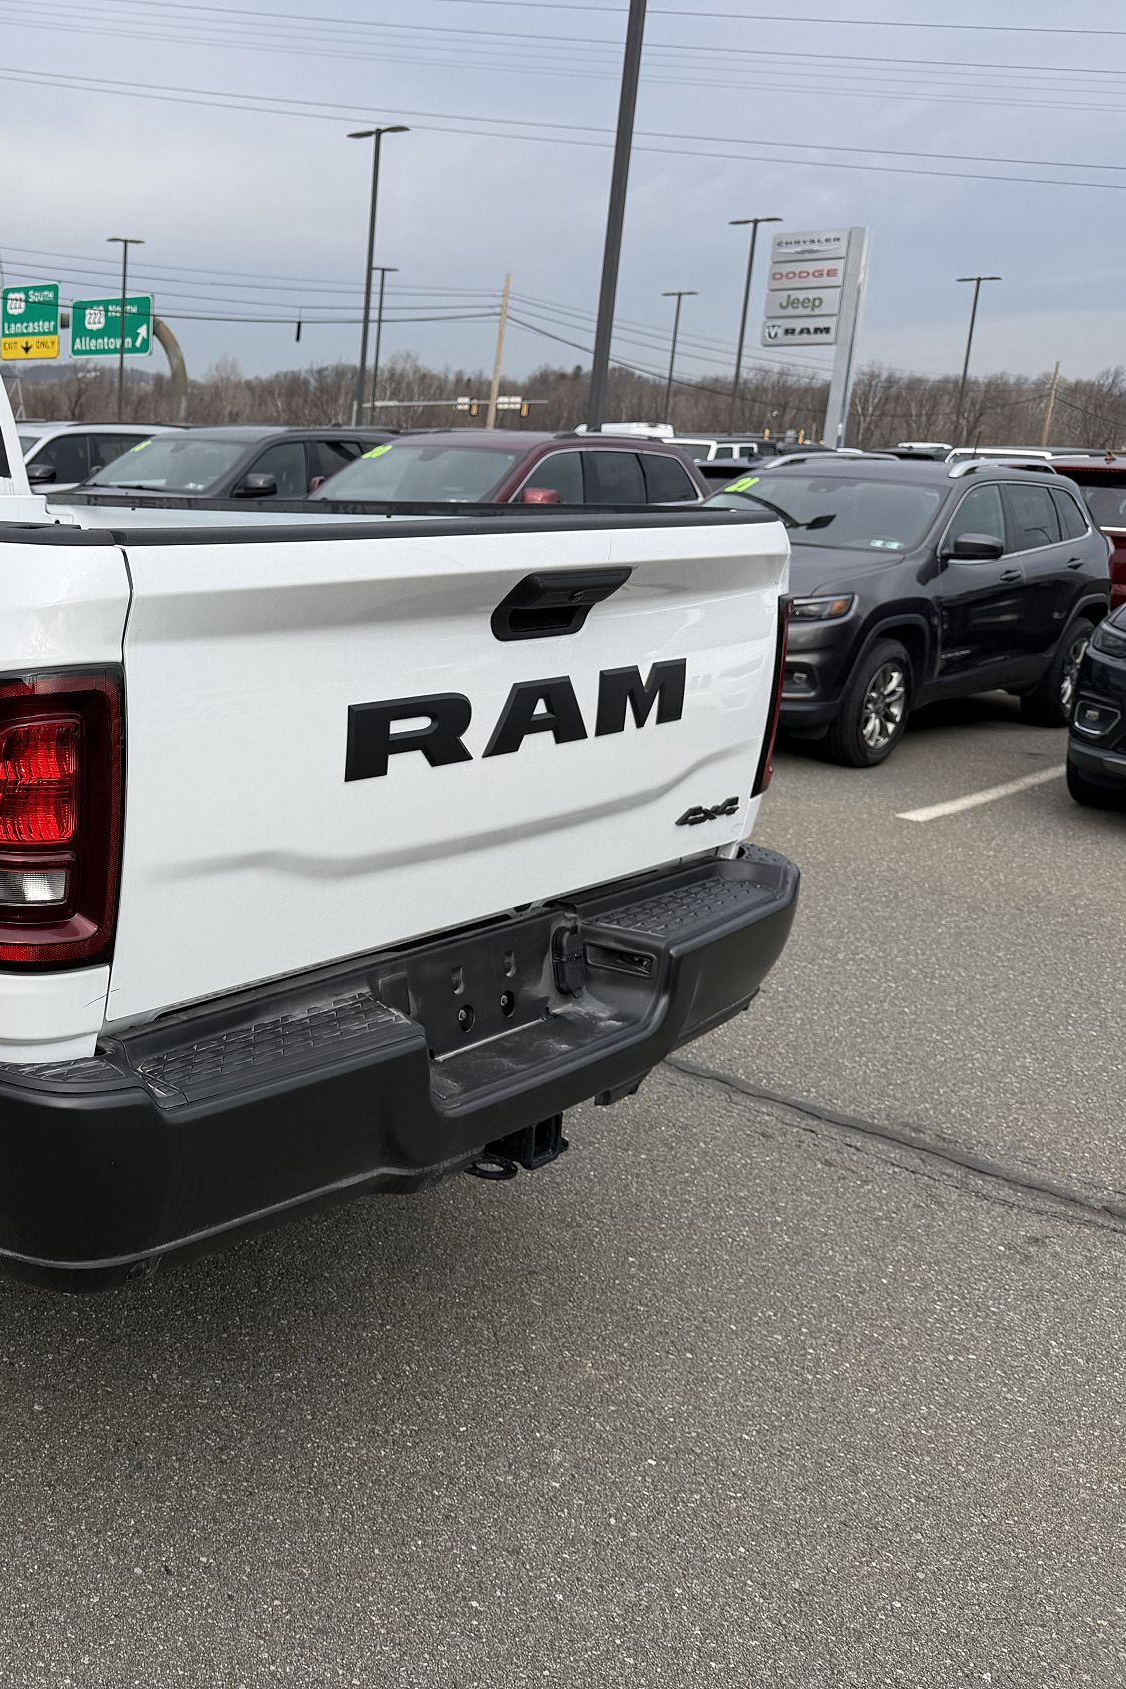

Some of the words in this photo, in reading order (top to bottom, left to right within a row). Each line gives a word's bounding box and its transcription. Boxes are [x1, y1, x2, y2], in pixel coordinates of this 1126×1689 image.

[777, 237, 841, 247] CHRYSLER
[772, 268, 838, 281] DODGE
[779, 294, 823, 311] Jeep
[87, 311, 103, 325] 222
[4, 320, 55, 334] Lancaster
[783, 326, 831, 336] RAM
[74, 336, 132, 350] Allentown
[345, 658, 687, 782] RAM
